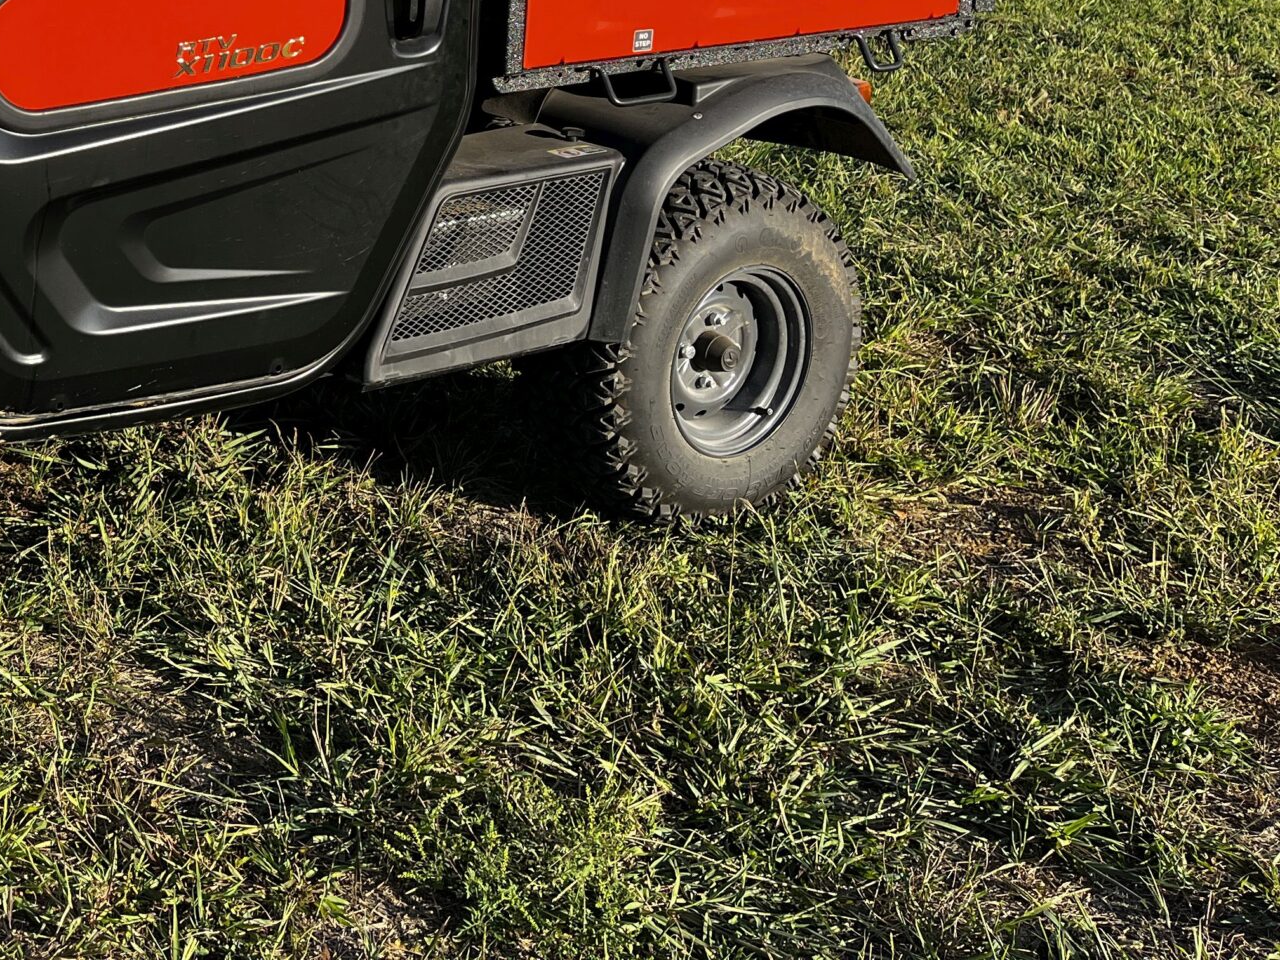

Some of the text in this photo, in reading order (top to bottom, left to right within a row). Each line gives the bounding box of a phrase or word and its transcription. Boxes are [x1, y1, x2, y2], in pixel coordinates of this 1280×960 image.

[638, 32, 649, 40] NO
[176, 34, 237, 57] RTV
[635, 40, 651, 48] STEP
[173, 37, 305, 78] X1100C
